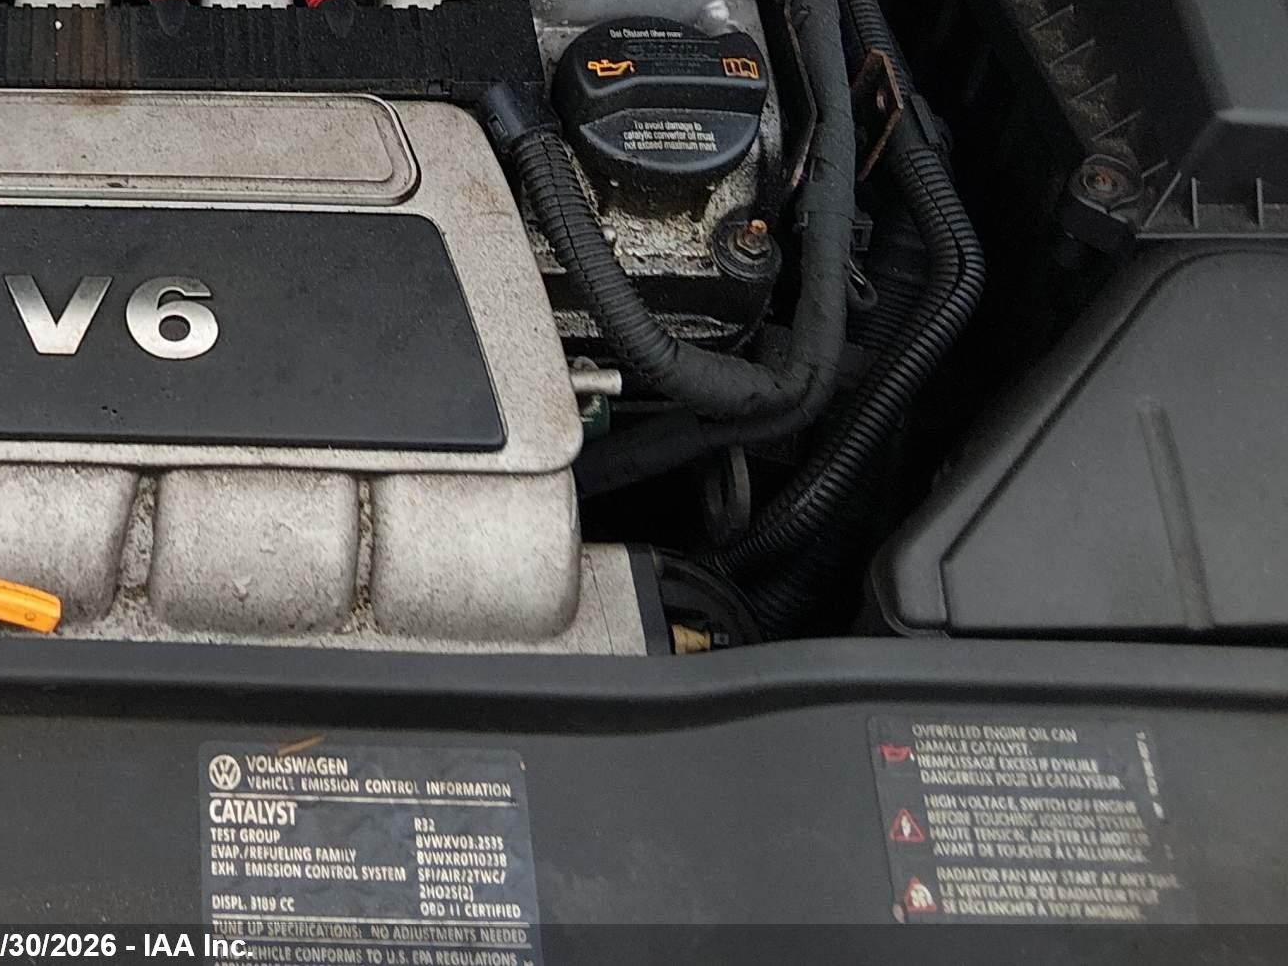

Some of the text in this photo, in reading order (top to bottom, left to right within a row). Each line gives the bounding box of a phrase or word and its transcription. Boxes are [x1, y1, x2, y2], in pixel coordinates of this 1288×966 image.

[634, 120, 702, 132] To avoid damage to
[623, 131, 715, 141] catalytic converter oil must
[624, 141, 717, 151] not exceed maximum mark
[4, 275, 220, 360] V6
[984, 725, 1027, 742] ENGINE
[1029, 726, 1047, 742] OIL
[1051, 727, 1078, 743] CAN
[246, 756, 348, 775] VOLKSWAGEN
[246, 777, 512, 797] VEHICLE EMISSION CONTROL INFORMATION
[209, 799, 297, 825] CATALYST
[924, 795, 957, 809] HIGH
[1020, 798, 1065, 813] SWITCH
[1068, 800, 1092, 813] OFF
[414, 818, 436, 832] R32
[927, 811, 970, 825] BEFORE
[211, 828, 281, 843] TEST GROUP
[211, 846, 357, 863] EVAP./REFUELING FAMILY
[211, 863, 406, 882] EXH. EMISSION CONTROL SYSTEM
[937, 867, 999, 883] RADIATOR
[1001, 869, 1027, 883] FAN
[212, 895, 247, 910] DISPL.
[280, 897, 295, 912] CC
[420, 903, 446, 917] OBD
[465, 904, 521, 918] CERTIFIED
[213, 921, 245, 936] TUNE
[247, 922, 264, 937] UP
[371, 925, 390, 940] NO
[393, 926, 477, 942] ADJUSTMENTS
[480, 928, 527, 944] NEEDED
[295, 946, 363, 963] CONFORMS
[367, 948, 383, 963] TO
[386, 949, 409, 964] U.S.
[412, 950, 433, 965] EPA
[436, 950, 518, 966] REGULATIONS
